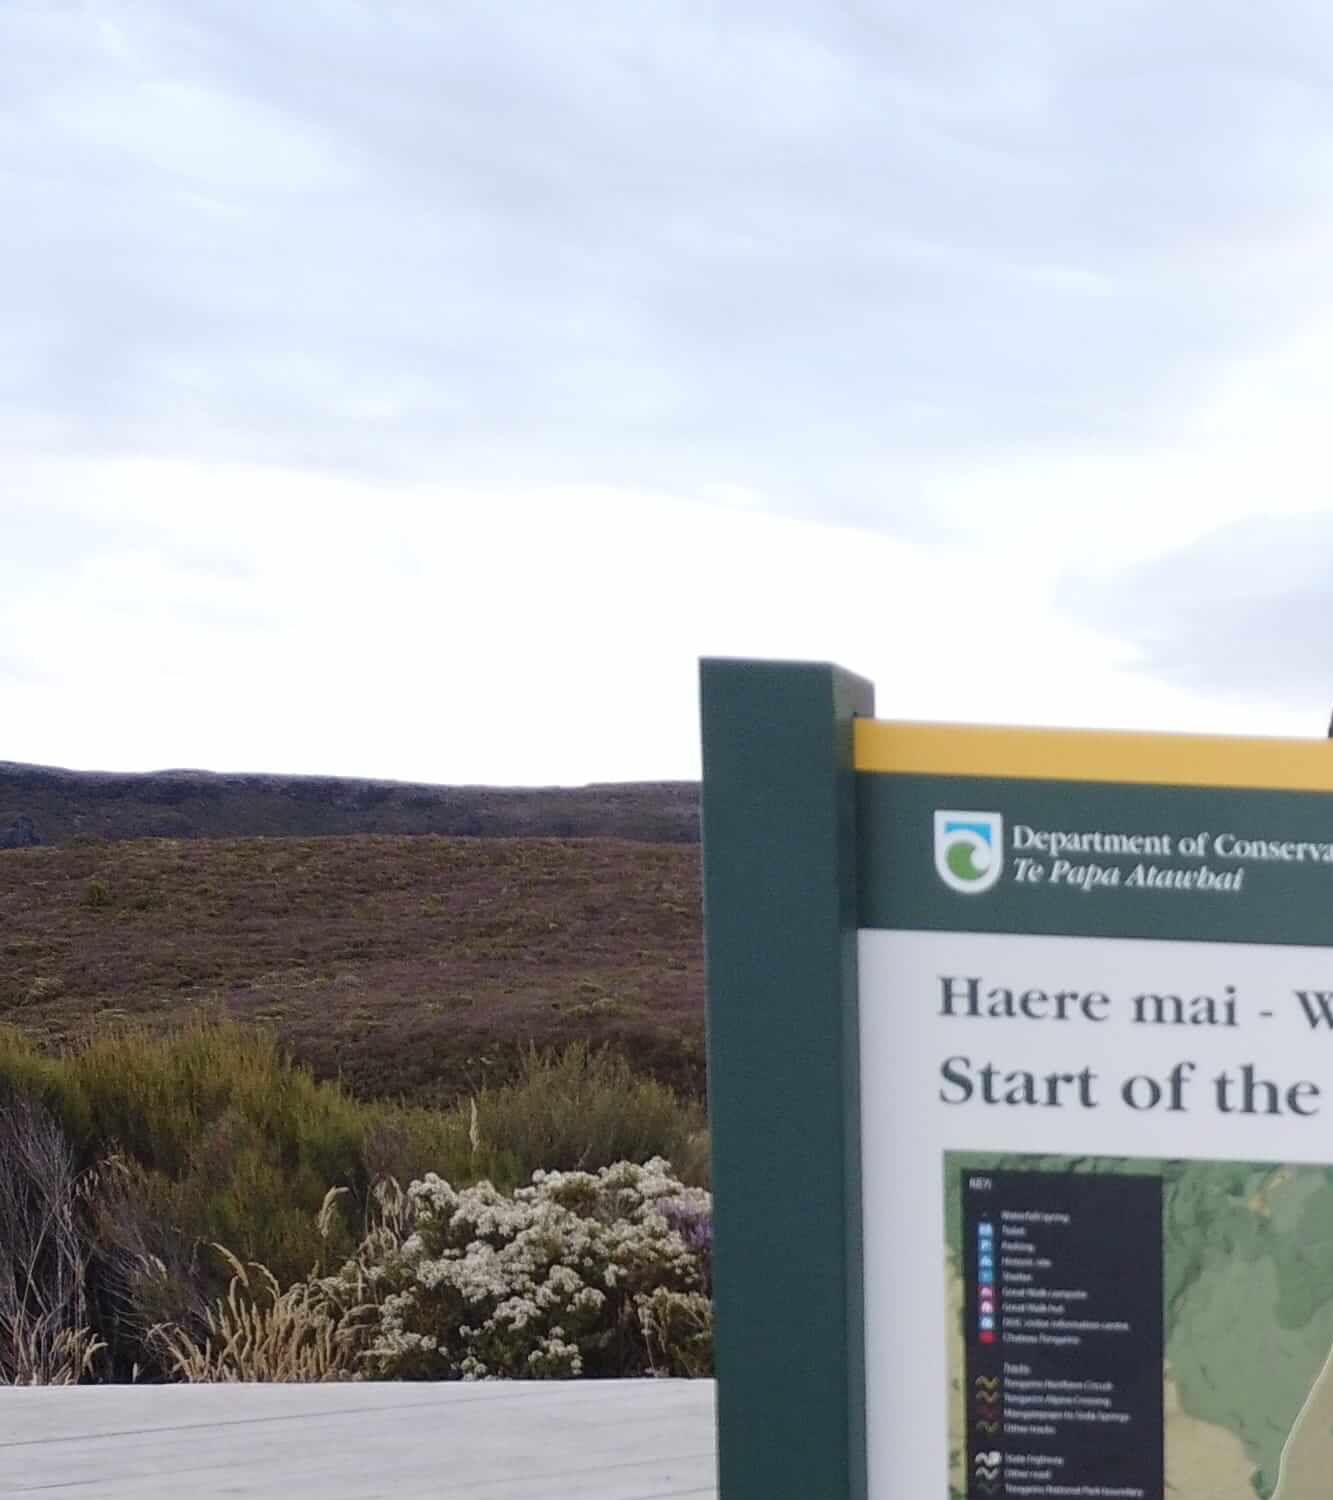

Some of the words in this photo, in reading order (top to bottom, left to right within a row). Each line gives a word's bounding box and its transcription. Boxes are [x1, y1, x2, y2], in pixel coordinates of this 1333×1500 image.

[1013, 827, 1171, 858] Department
[1178, 831, 1209, 857] of
[1013, 857, 1043, 882] Te
[1049, 860, 1120, 891] Papa
[941, 977, 1108, 1021] Haere
[1136, 985, 1239, 1026] mai
[939, 1057, 1096, 1106] Start
[1120, 1062, 1193, 1110] of
[1215, 1065, 1318, 1115] the
